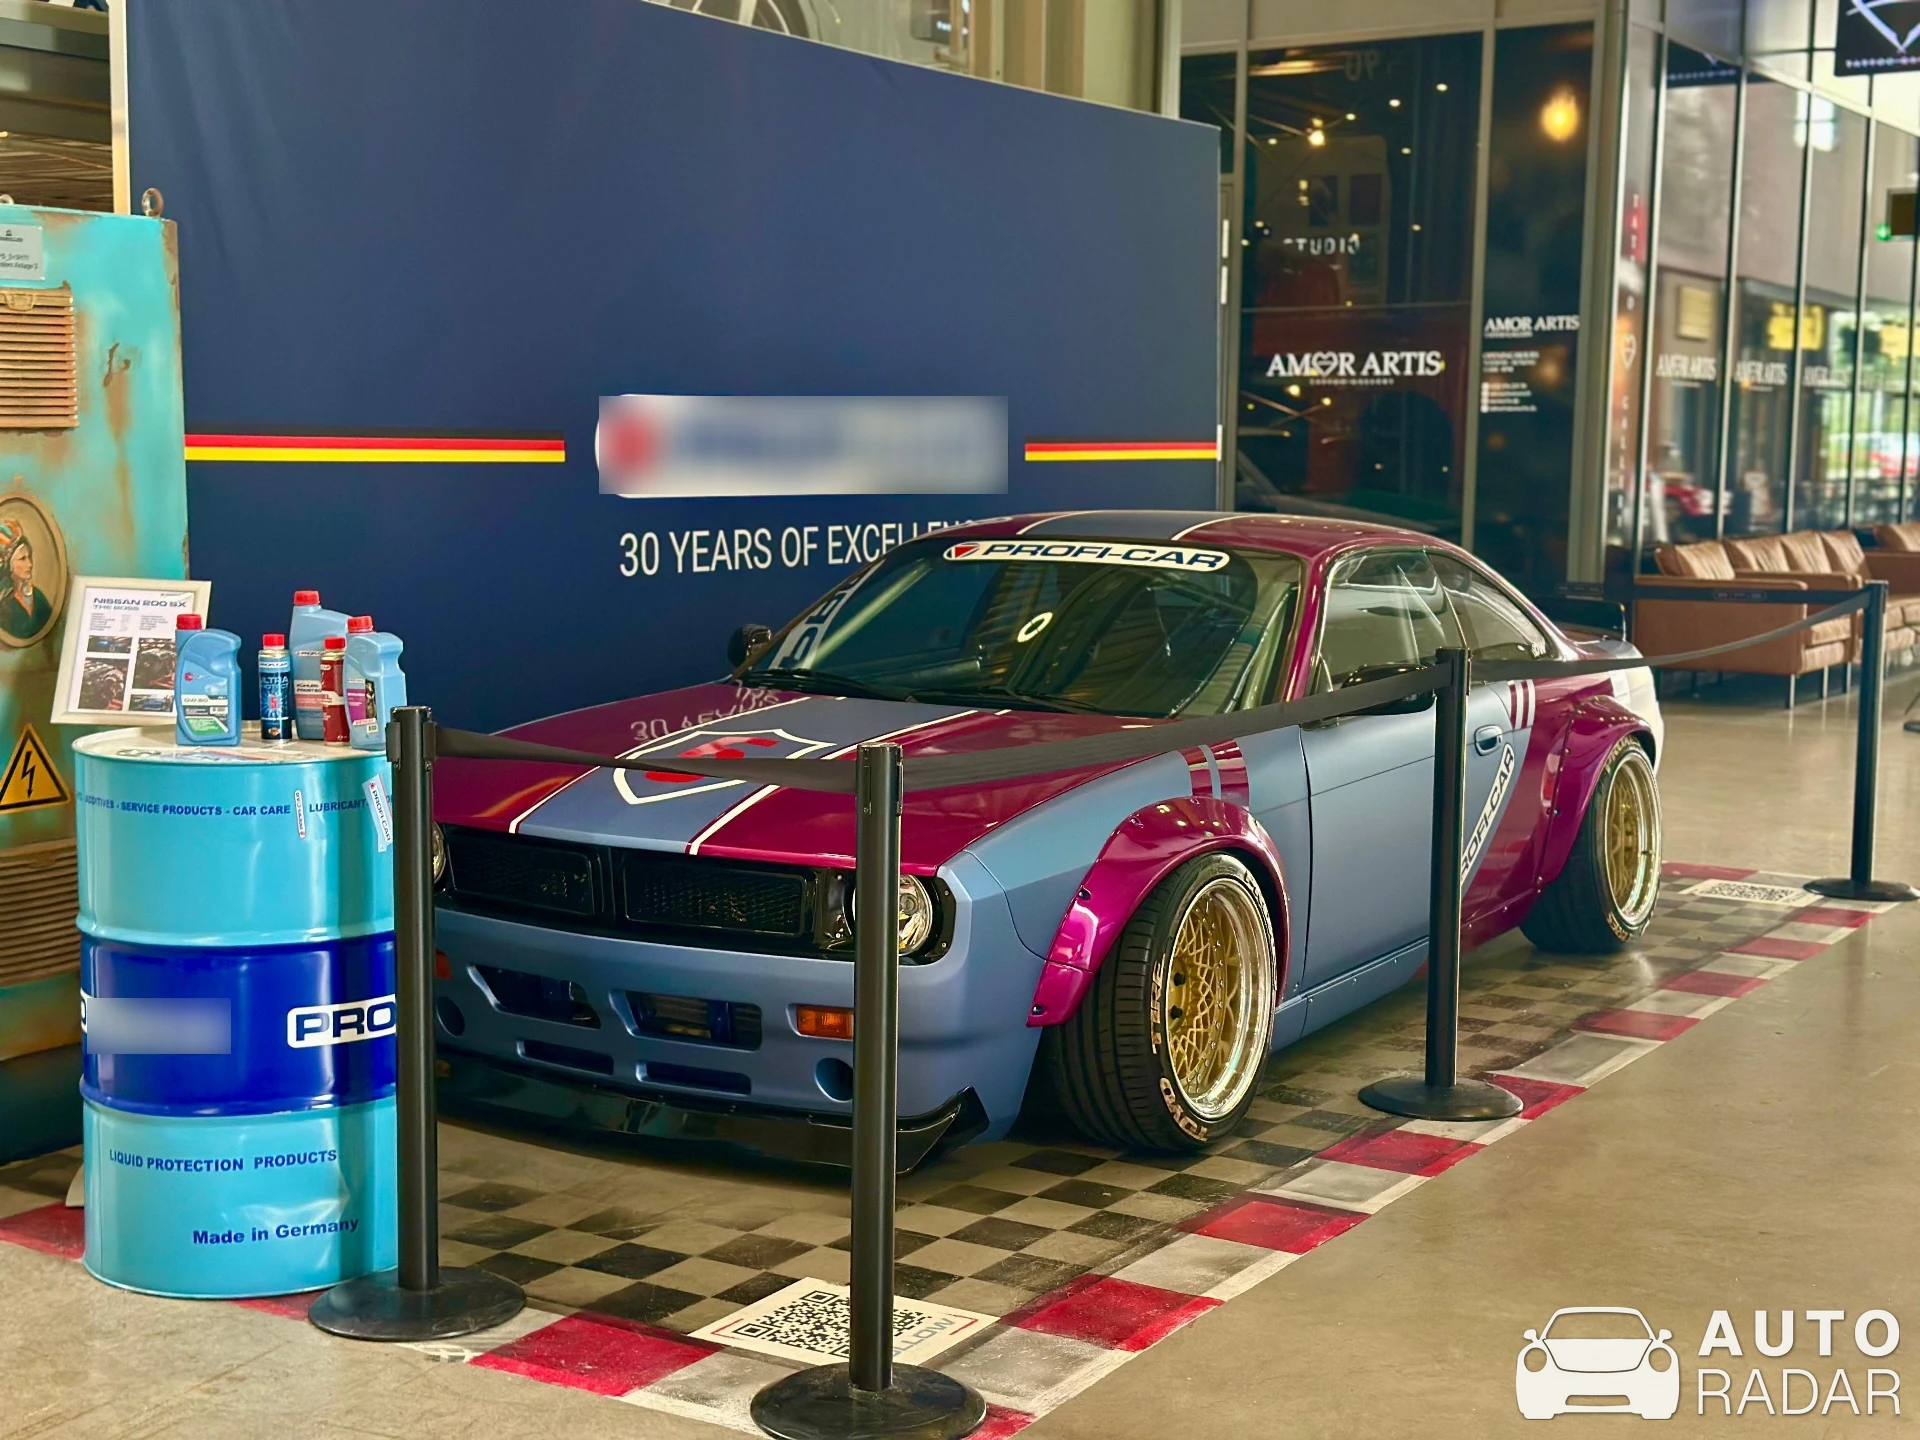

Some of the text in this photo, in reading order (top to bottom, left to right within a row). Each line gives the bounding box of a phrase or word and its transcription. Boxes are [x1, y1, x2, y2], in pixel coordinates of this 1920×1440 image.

[1534, 314, 1580, 331] ARTIS
[1360, 351, 1442, 376] ARTIS
[619, 532, 659, 577] 30
[669, 527, 772, 573] YEARS
[781, 526, 819, 567] OF
[982, 543, 1223, 568] PROFI-CAR
[93, 598, 140, 606] NISSAN
[121, 801, 160, 814] SERVICE
[162, 804, 223, 816] PRODUCTS
[233, 806, 257, 816] CAR
[260, 805, 291, 815] CARE
[309, 798, 369, 813] LUBRICANT
[1461, 747, 1513, 879] ROFI-CAR
[109, 1149, 337, 1172] LIQUID PROTECTION PRODUCTS
[193, 1218, 359, 1244] Made in Germany
